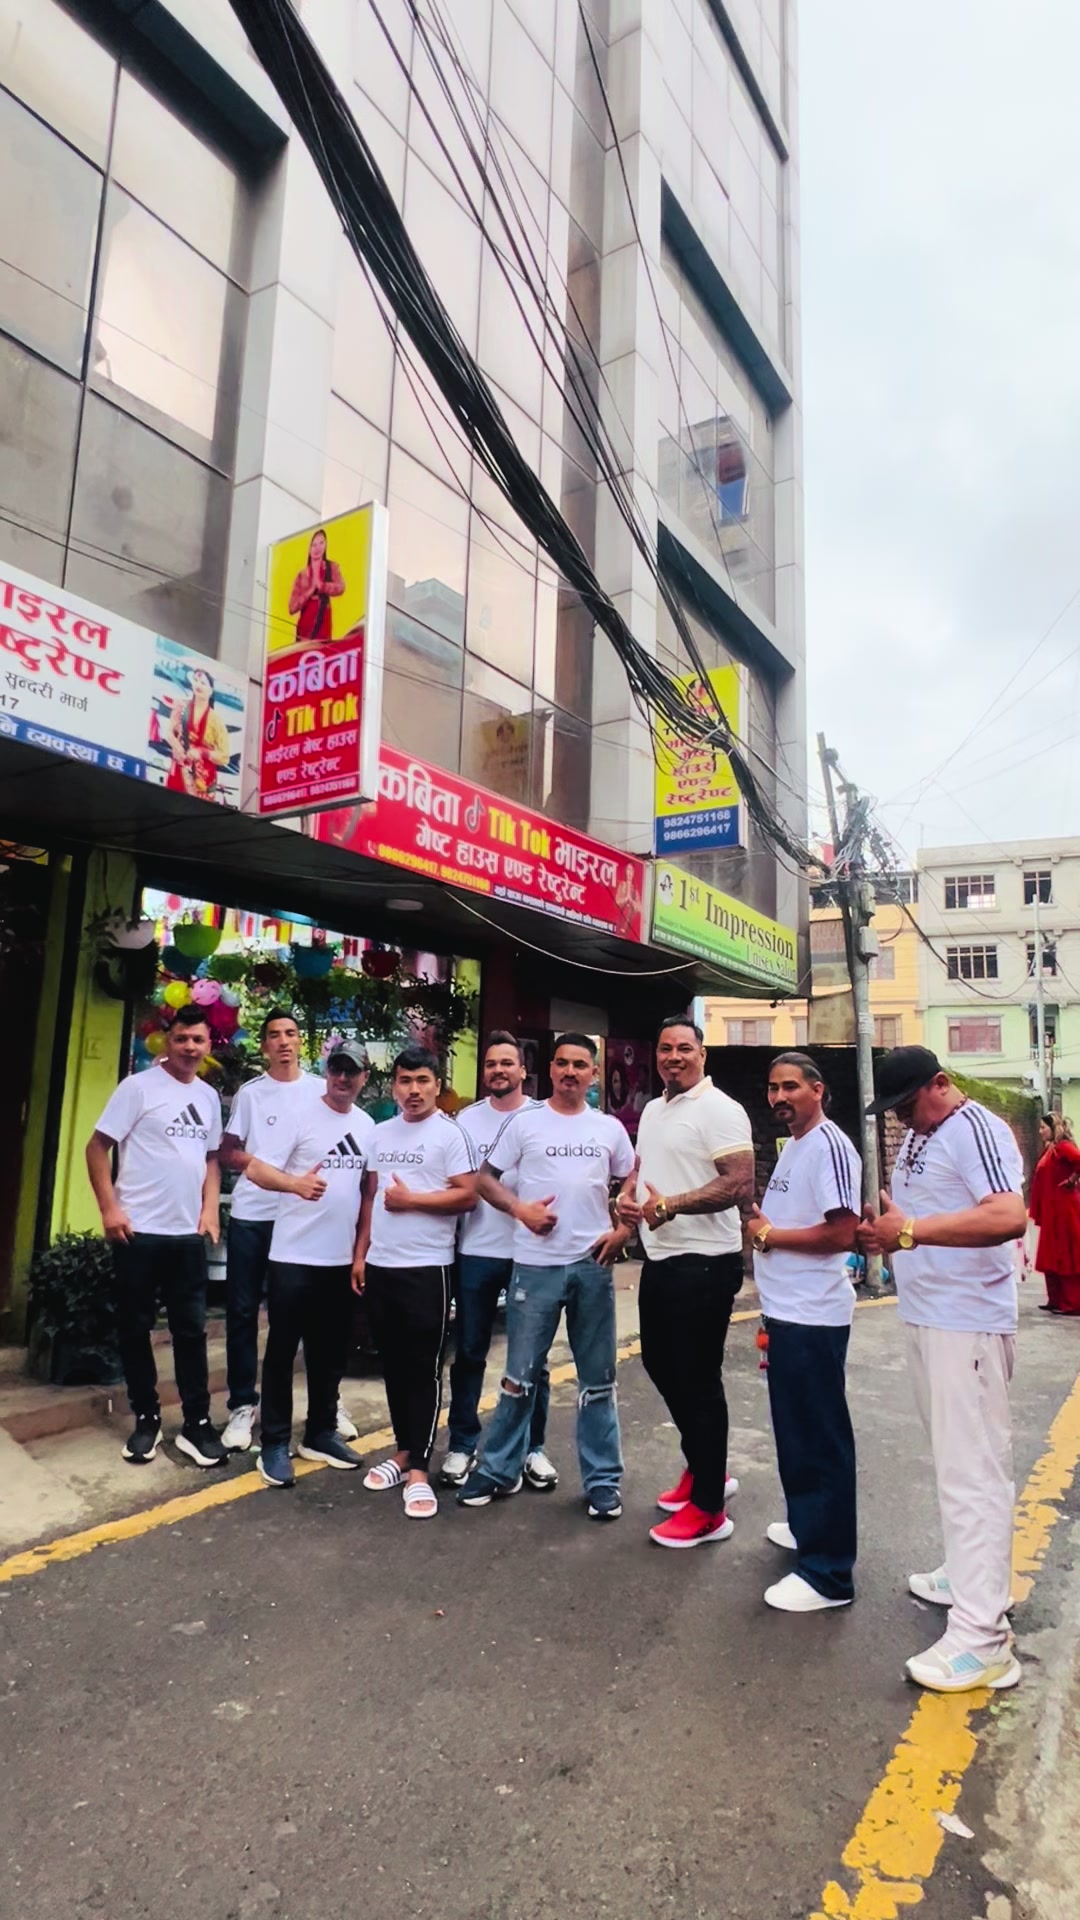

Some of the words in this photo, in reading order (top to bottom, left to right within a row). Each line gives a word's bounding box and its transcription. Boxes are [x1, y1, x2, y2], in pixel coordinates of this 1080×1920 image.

[0, 579, 112, 650] ाइरल
[0, 623, 125, 694] ष्टुरेण्ट
[286, 704, 316, 737] Tik
[320, 692, 359, 728] Tok
[488, 806, 516, 846] Tik
[520, 819, 551, 860] Tok
[663, 810, 731, 828] 9824751168
[663, 823, 731, 841] 9866296417
[456, 839, 500, 875] हाउस
[504, 856, 534, 885] एण्ड
[705, 891, 794, 961] Impression
[165, 1125, 208, 1140] adidas
[323, 1155, 367, 1169] adida
[377, 1150, 424, 1164] adidas
[546, 1144, 602, 1157] adidas
